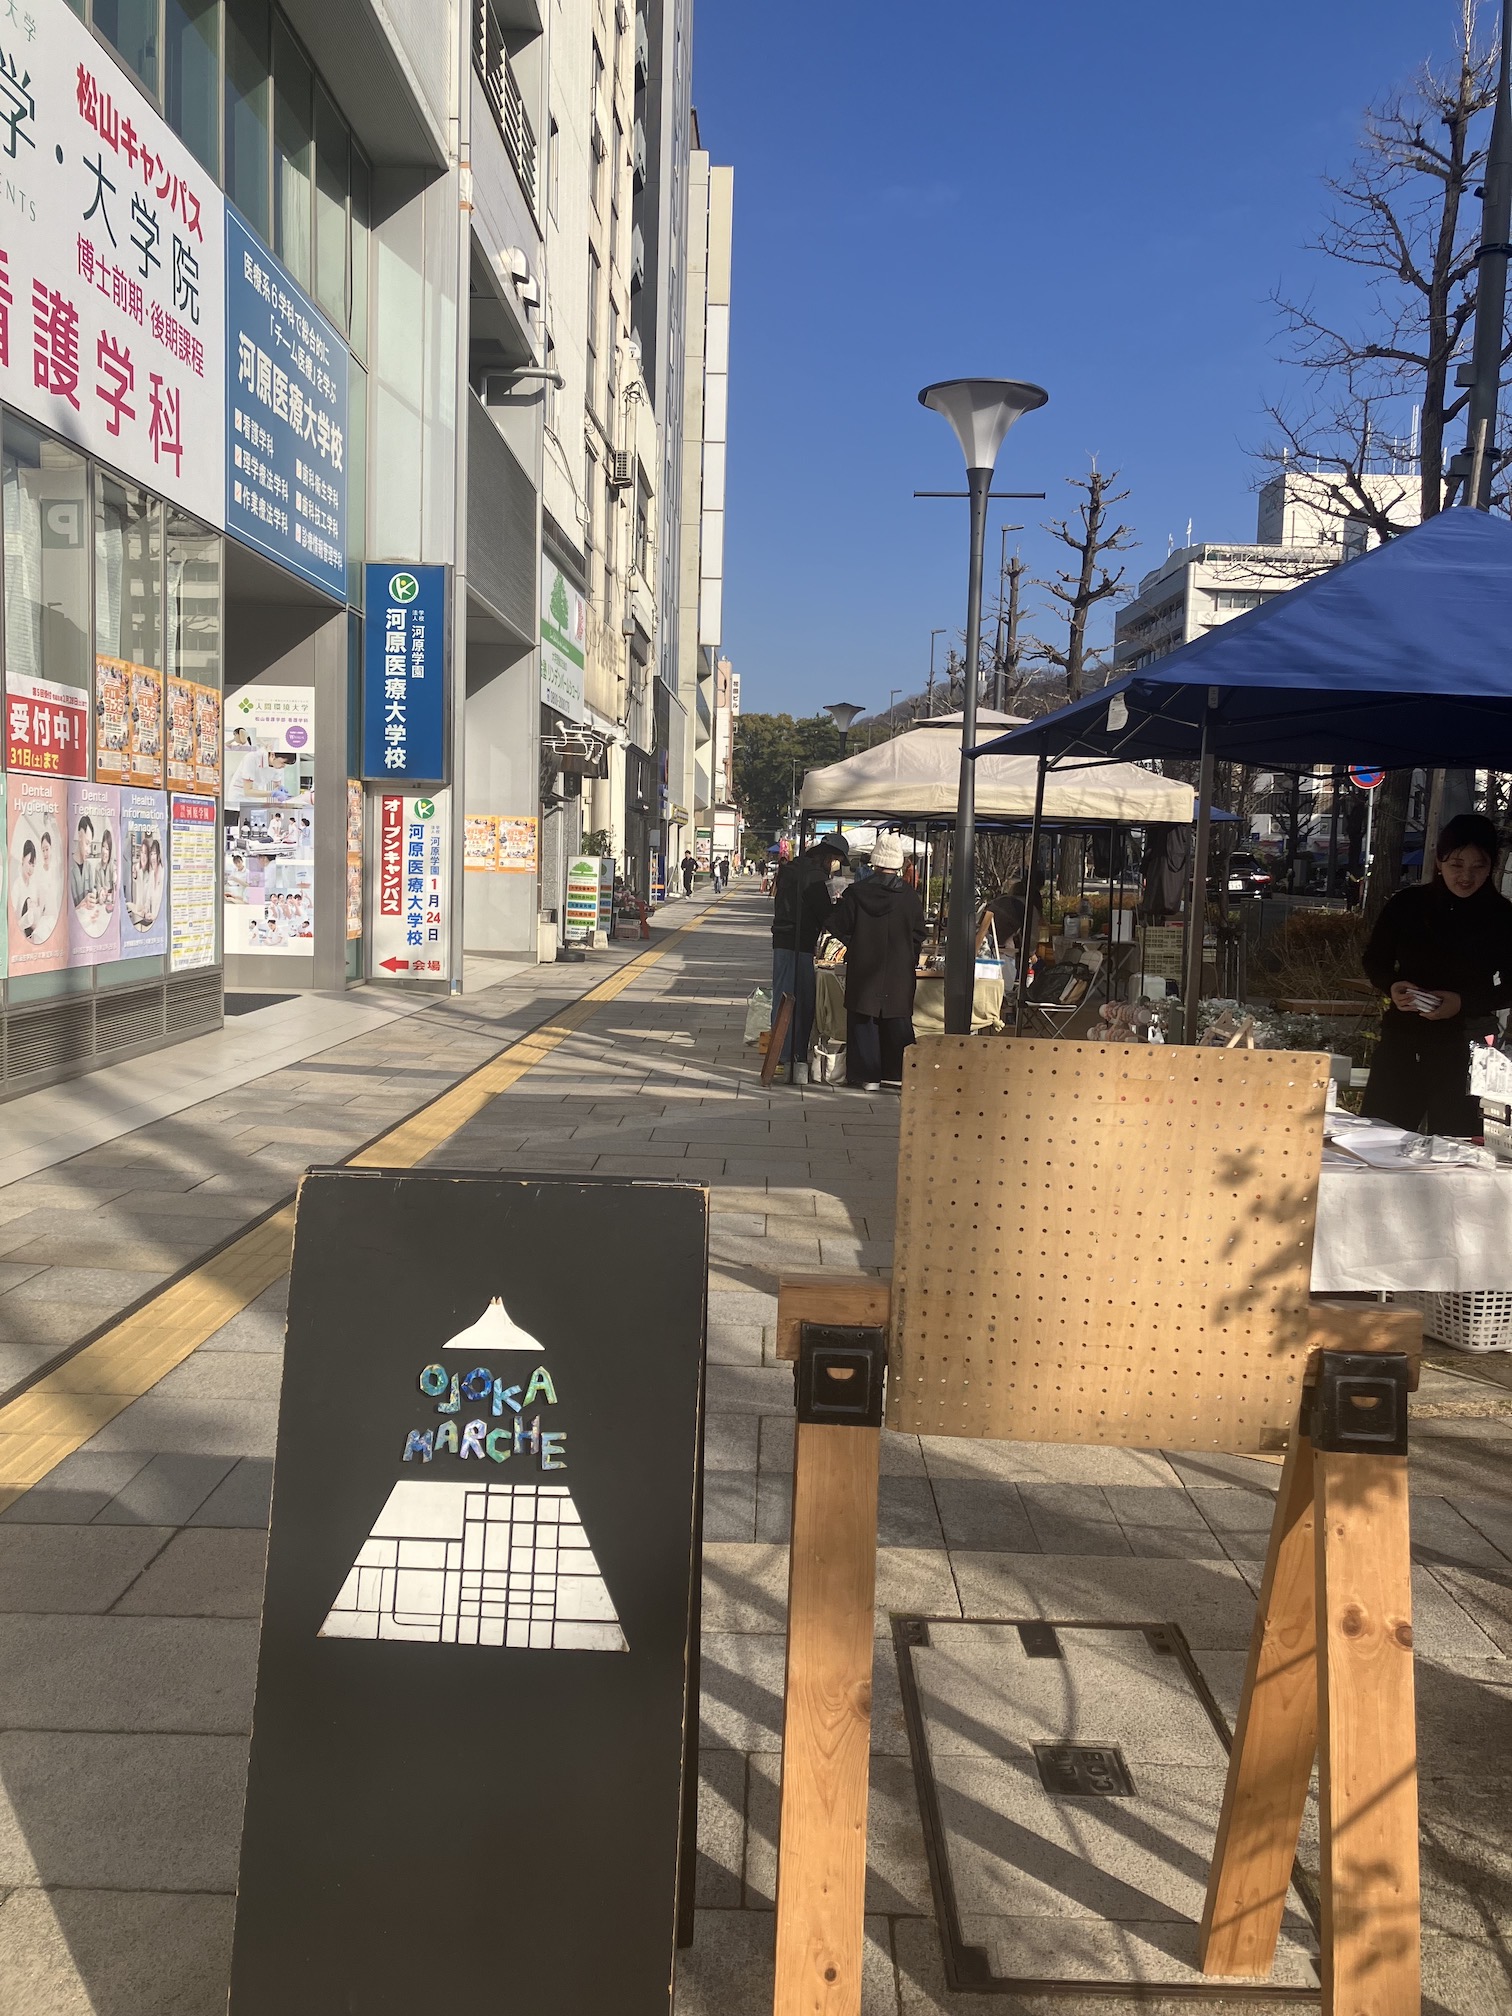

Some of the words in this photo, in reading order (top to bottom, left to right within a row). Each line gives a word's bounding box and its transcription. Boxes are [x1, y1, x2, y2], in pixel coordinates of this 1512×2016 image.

[76, 62, 204, 242] 松山キャンパス
[76, 232, 204, 378] 博士前期・後期課程
[244, 251, 330, 366] 医療系6学科で総合的に
[270, 314, 337, 404] 「チーム医療」を学ぶ
[238, 330, 343, 473] 河原医療大学校
[243, 413, 274, 459] 看護学科
[243, 449, 289, 503] 理学療法学科
[302, 464, 339, 510] 歯科衛生学科
[243, 486, 288, 535] 作業療法学科
[302, 495, 339, 540] 歯科技工学科
[301, 526, 343, 572] 診療情報管理学科
[411, 624, 426, 679] 河原学園
[255, 703, 309, 711] 人間環境大学
[384, 608, 407, 769] 河原医療大学校
[10, 747, 59, 770] 31日(土)まで
[14, 798, 59, 815] Hygienist
[22, 783, 53, 798] Dental
[73, 803, 116, 817] Technician
[82, 789, 108, 802] Dental
[122, 806, 164, 820] Information
[131, 794, 155, 806] Health
[128, 820, 159, 835] Manager
[383, 799, 401, 912] オープンキャンパス
[430, 836, 441, 876] 河原学園
[407, 824, 424, 946] 河原医療大学校
[412, 960, 441, 971] 会場
[420, 1364, 557, 1416] OJOKA
[403, 1415, 567, 1470] MARCHE
